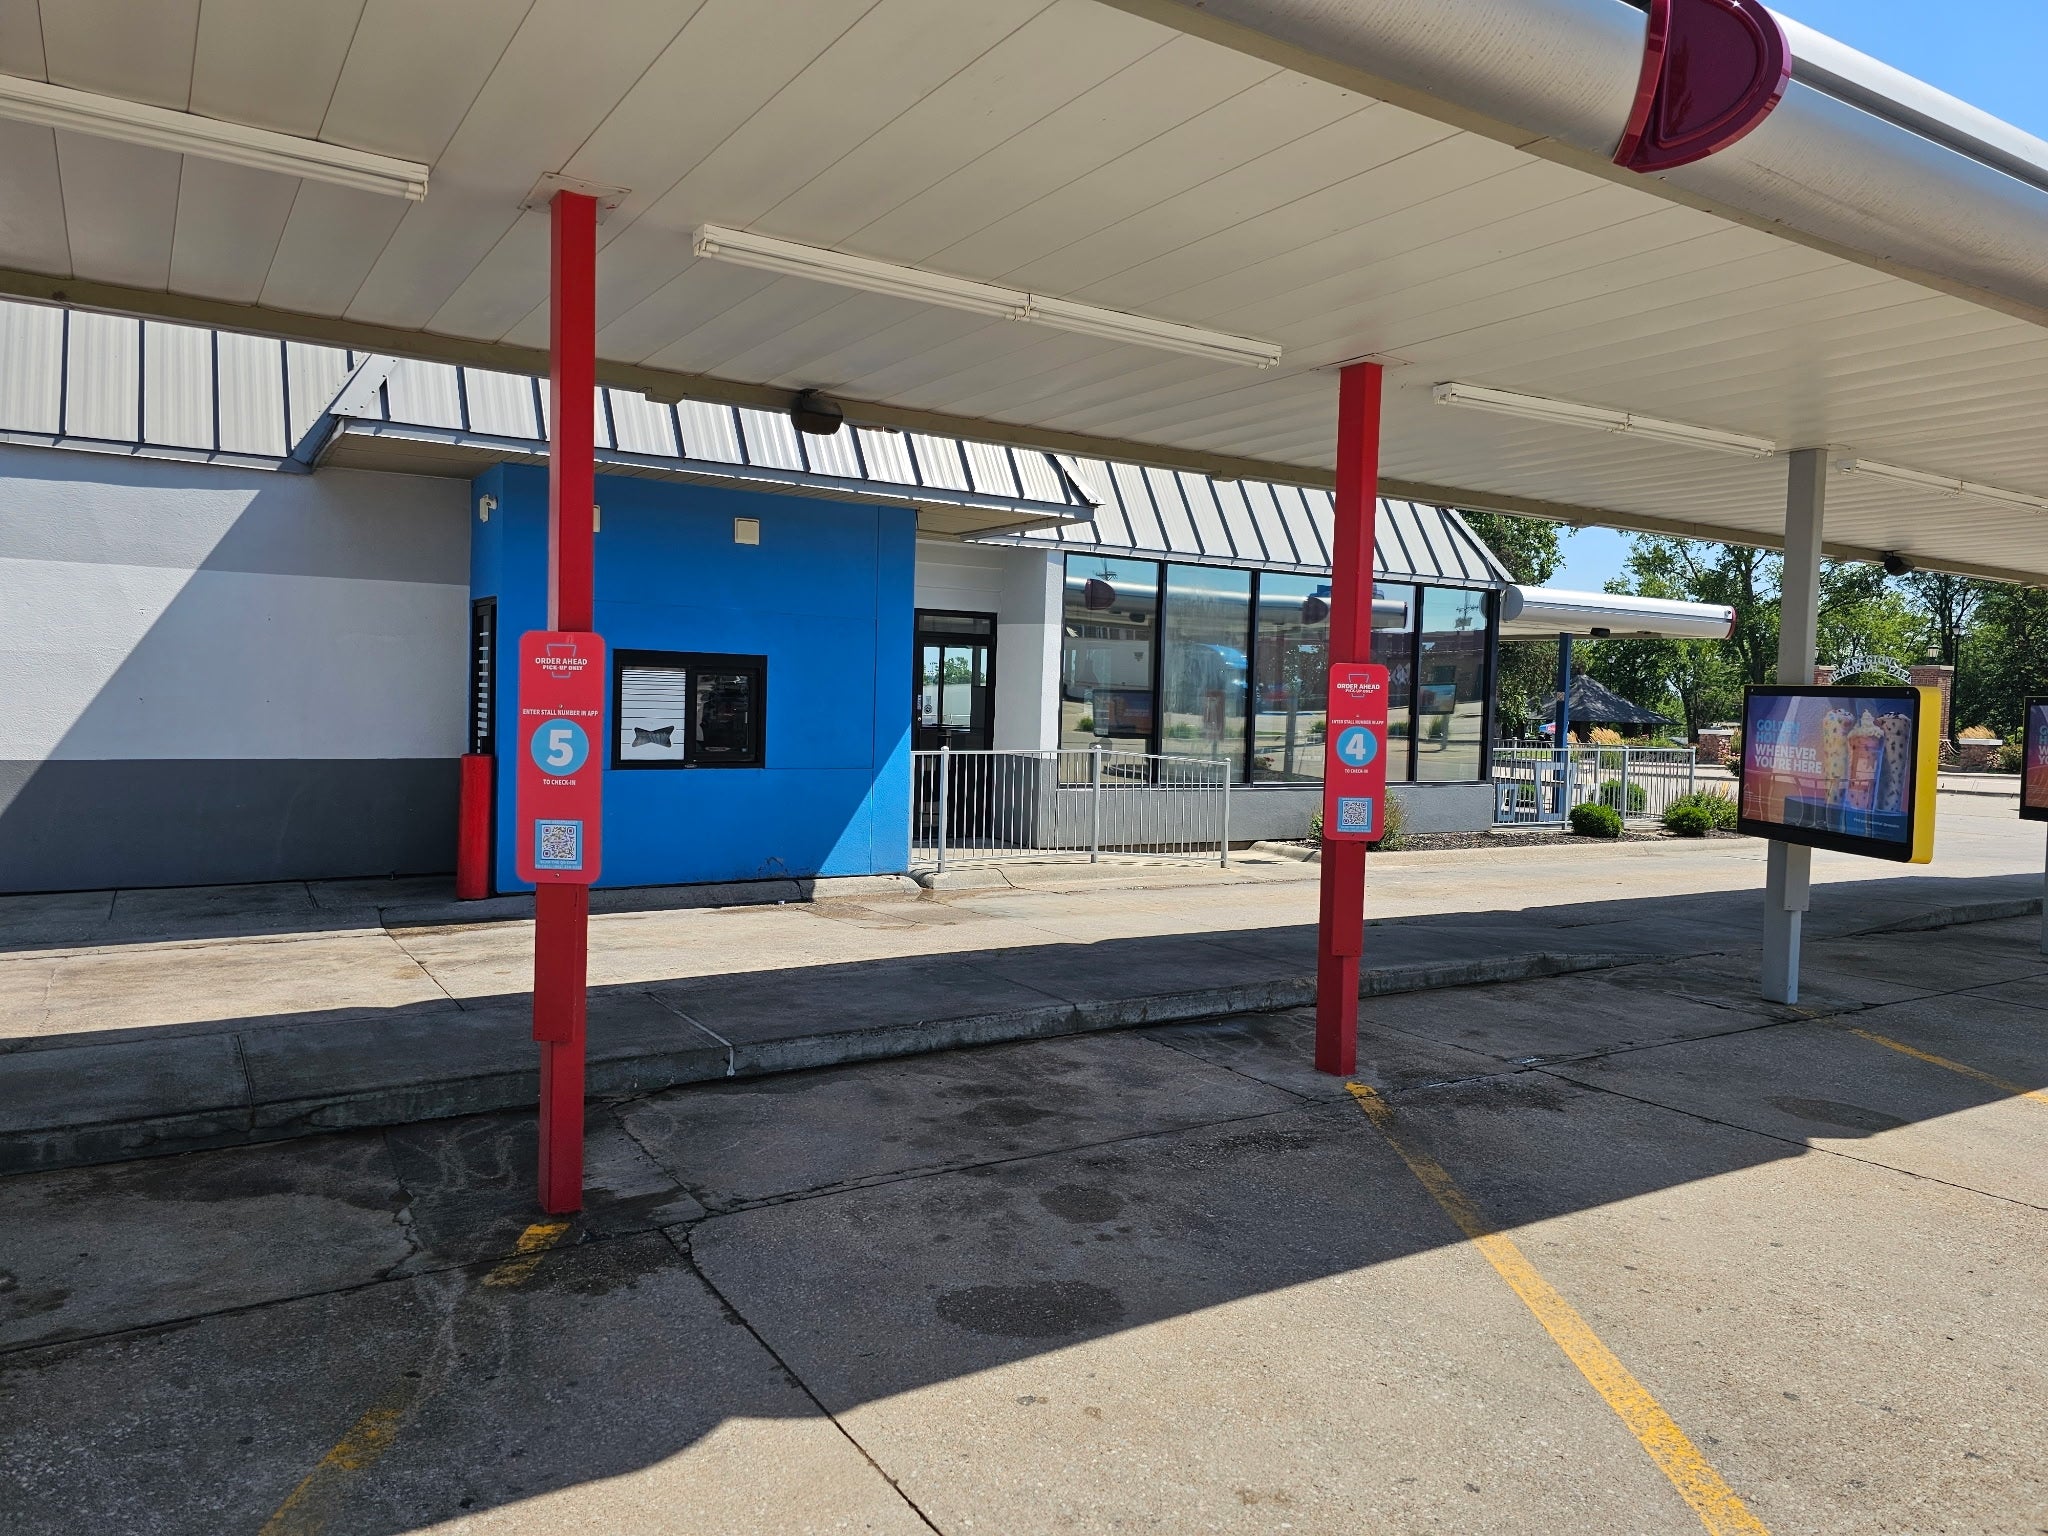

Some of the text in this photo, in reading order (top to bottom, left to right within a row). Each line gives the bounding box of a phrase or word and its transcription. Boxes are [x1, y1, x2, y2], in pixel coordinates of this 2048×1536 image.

[535, 657, 588, 666] ORDER AHEAD
[546, 729, 573, 767] 5
[1345, 733, 1366, 761] 4
[1755, 743, 1817, 760] WHENEVER
[1754, 755, 1823, 774] YOU'RE HERE
